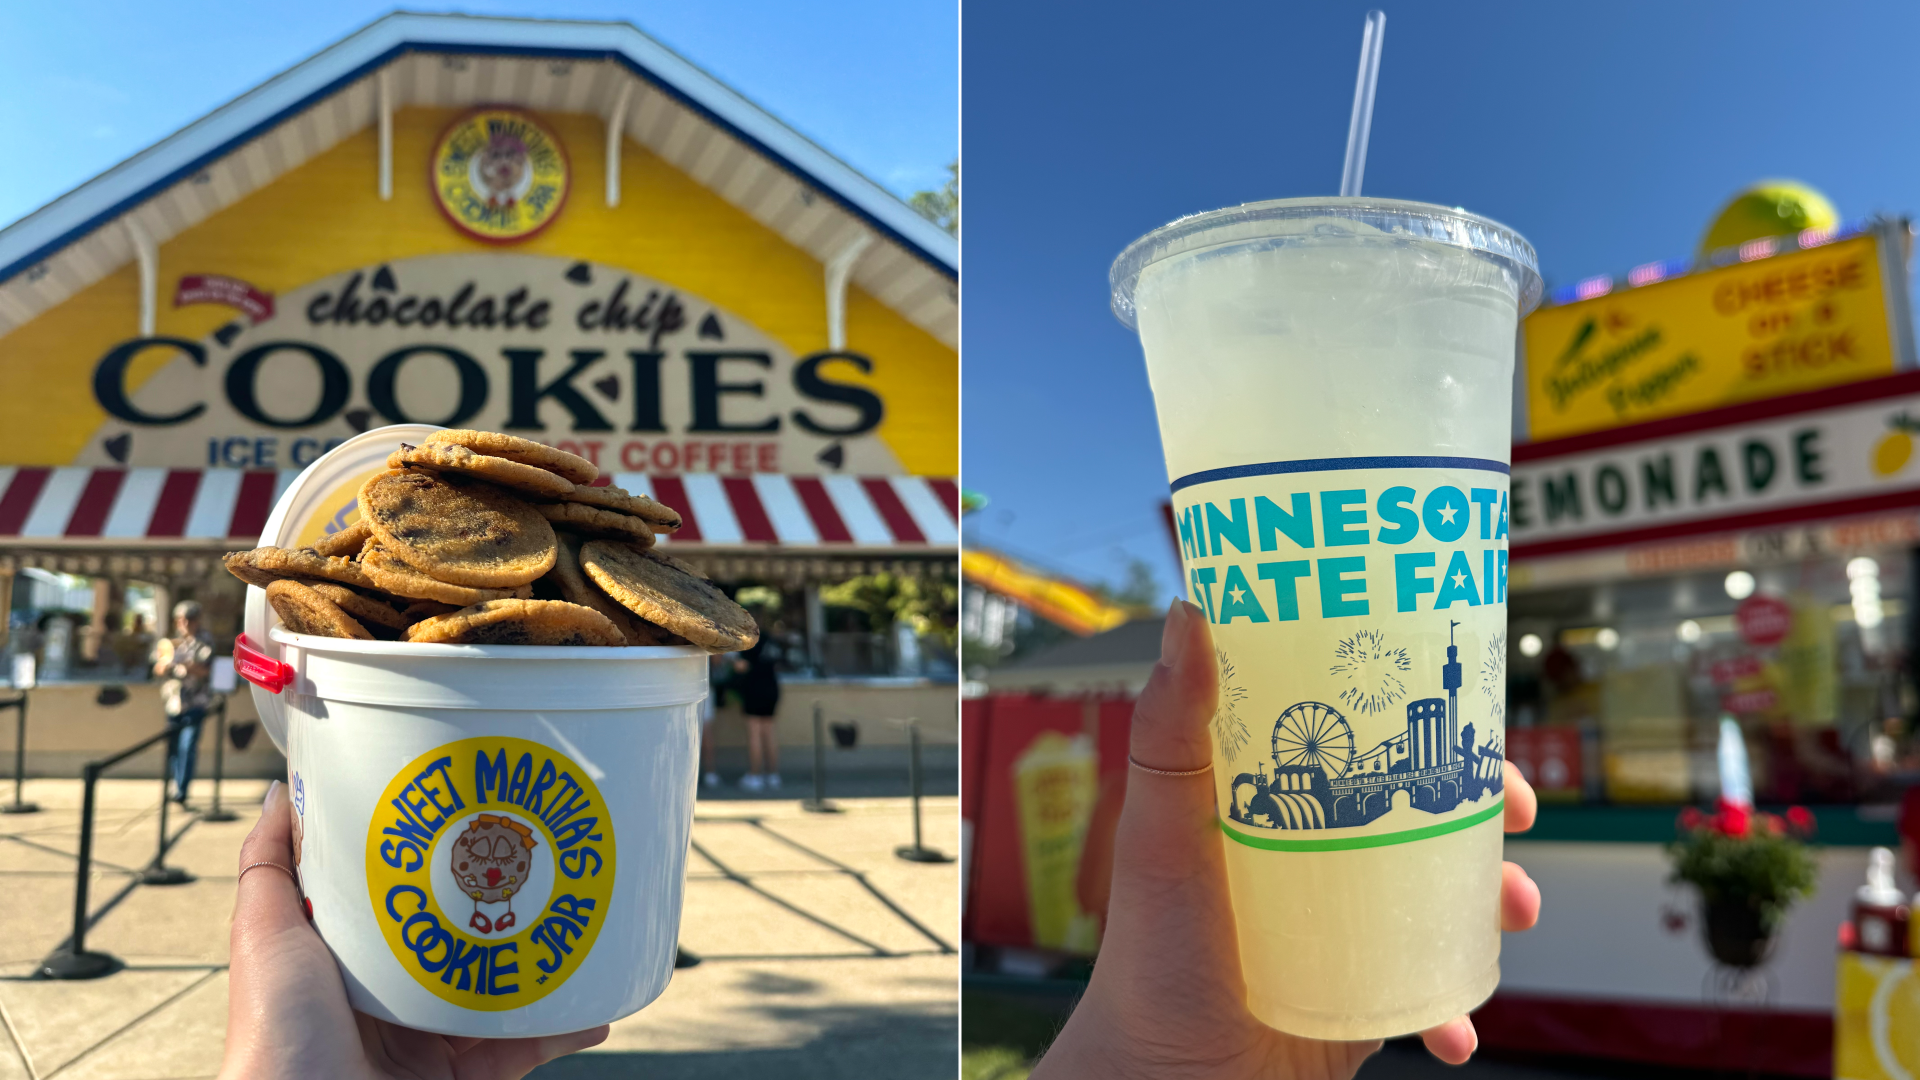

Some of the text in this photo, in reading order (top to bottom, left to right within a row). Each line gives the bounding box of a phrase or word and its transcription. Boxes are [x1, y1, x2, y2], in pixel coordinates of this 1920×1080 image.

[306, 271, 552, 329] chocolate
[576, 276, 688, 350] chip
[1712, 258, 1868, 317] CHEESE
[92, 336, 885, 438] COOKIES
[1741, 329, 1858, 381] STICK
[208, 436, 277, 468] ICE
[620, 440, 781, 473] COFFEE
[1510, 429, 1827, 530] EMONADE
[1176, 485, 1509, 561] MINNESOTA
[1190, 549, 1509, 625] STATE FAIR
[380, 747, 603, 880] SWEET MARTHA'S
[385, 884, 597, 996] COOKIE JAR
